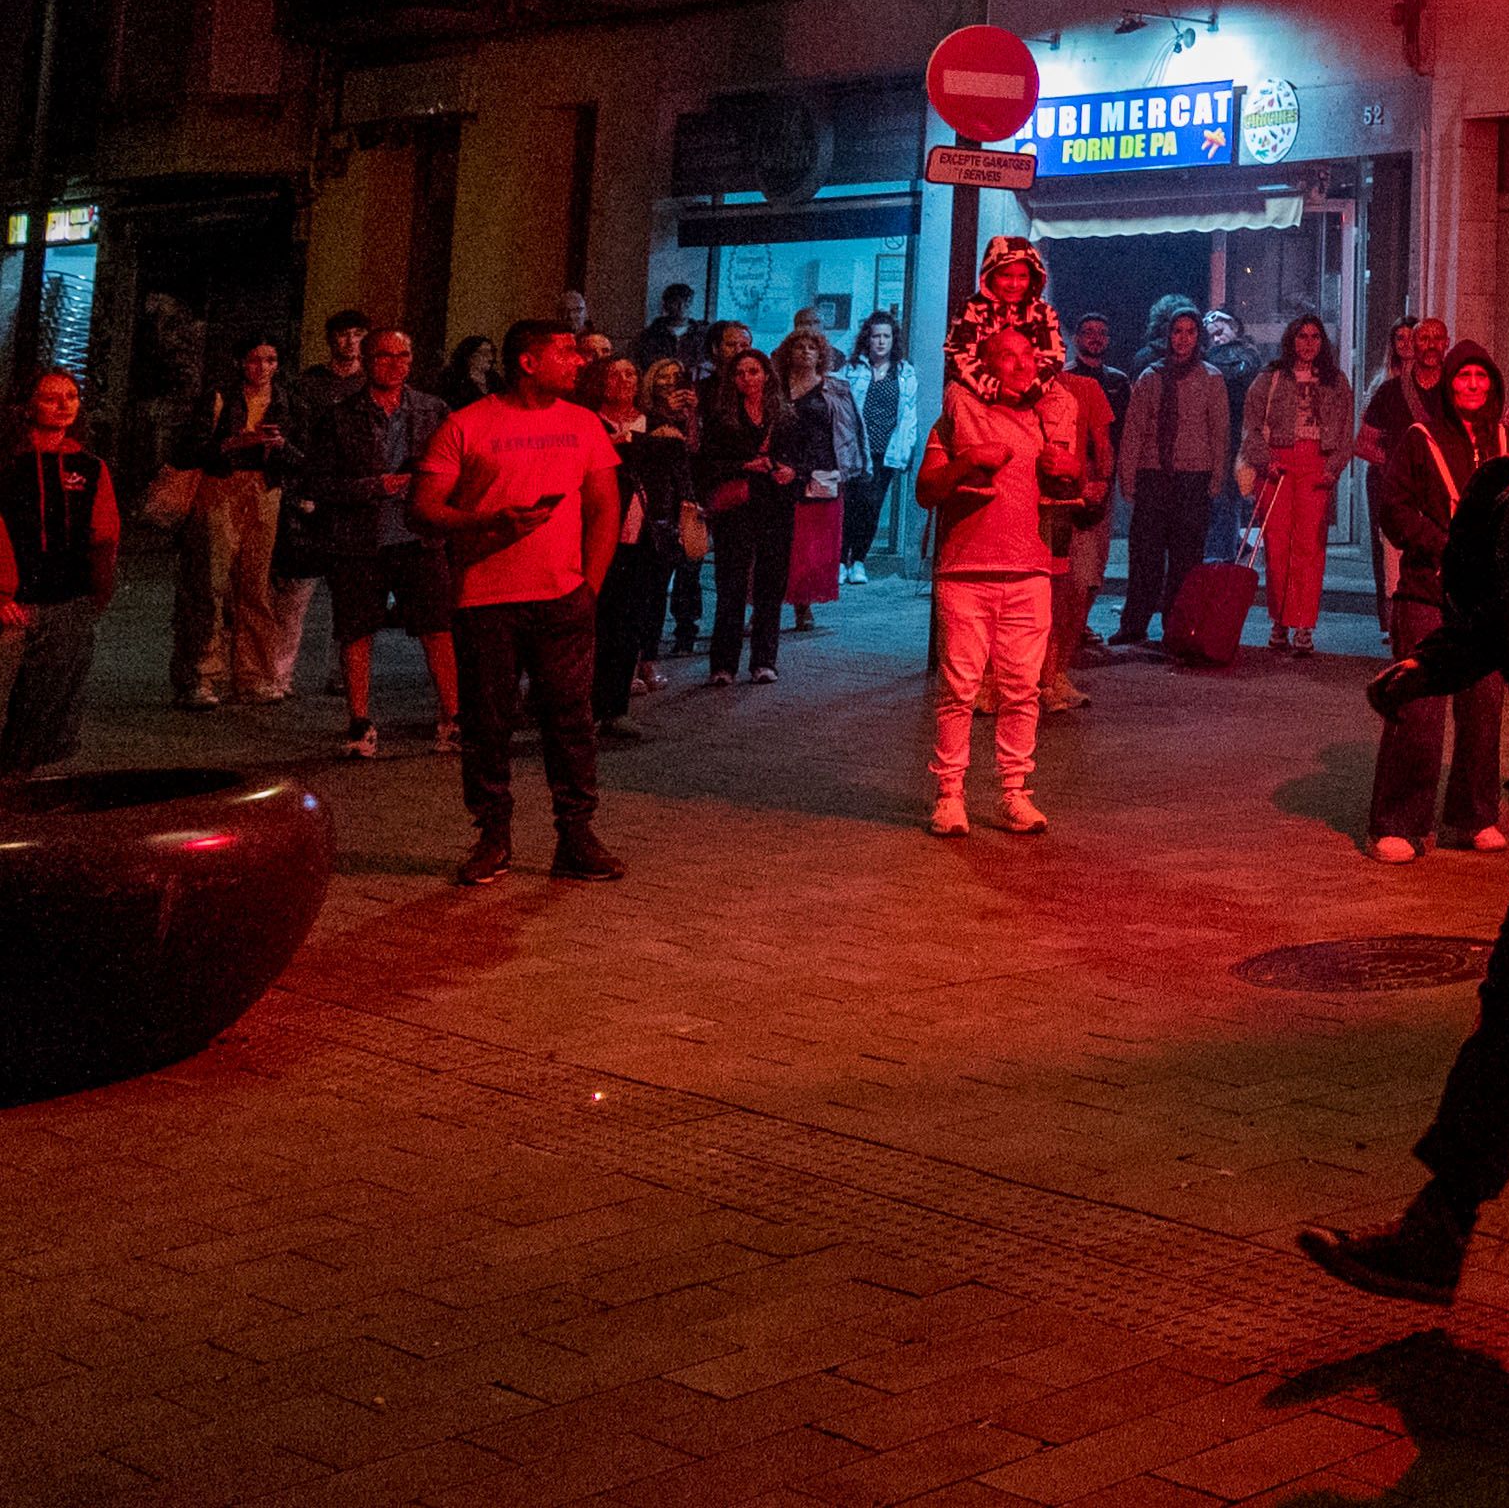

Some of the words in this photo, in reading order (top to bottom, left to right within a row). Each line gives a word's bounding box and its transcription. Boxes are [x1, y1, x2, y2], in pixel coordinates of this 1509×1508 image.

[1100, 89, 1232, 132] MERCAT
[1363, 104, 1384, 126] 52
[1062, 135, 1116, 164] FORN
[1119, 133, 1146, 160] DE
[1149, 130, 1177, 157] PA
[939, 152, 981, 167] EXCEPTE
[964, 169, 1002, 182] SERVEIS
